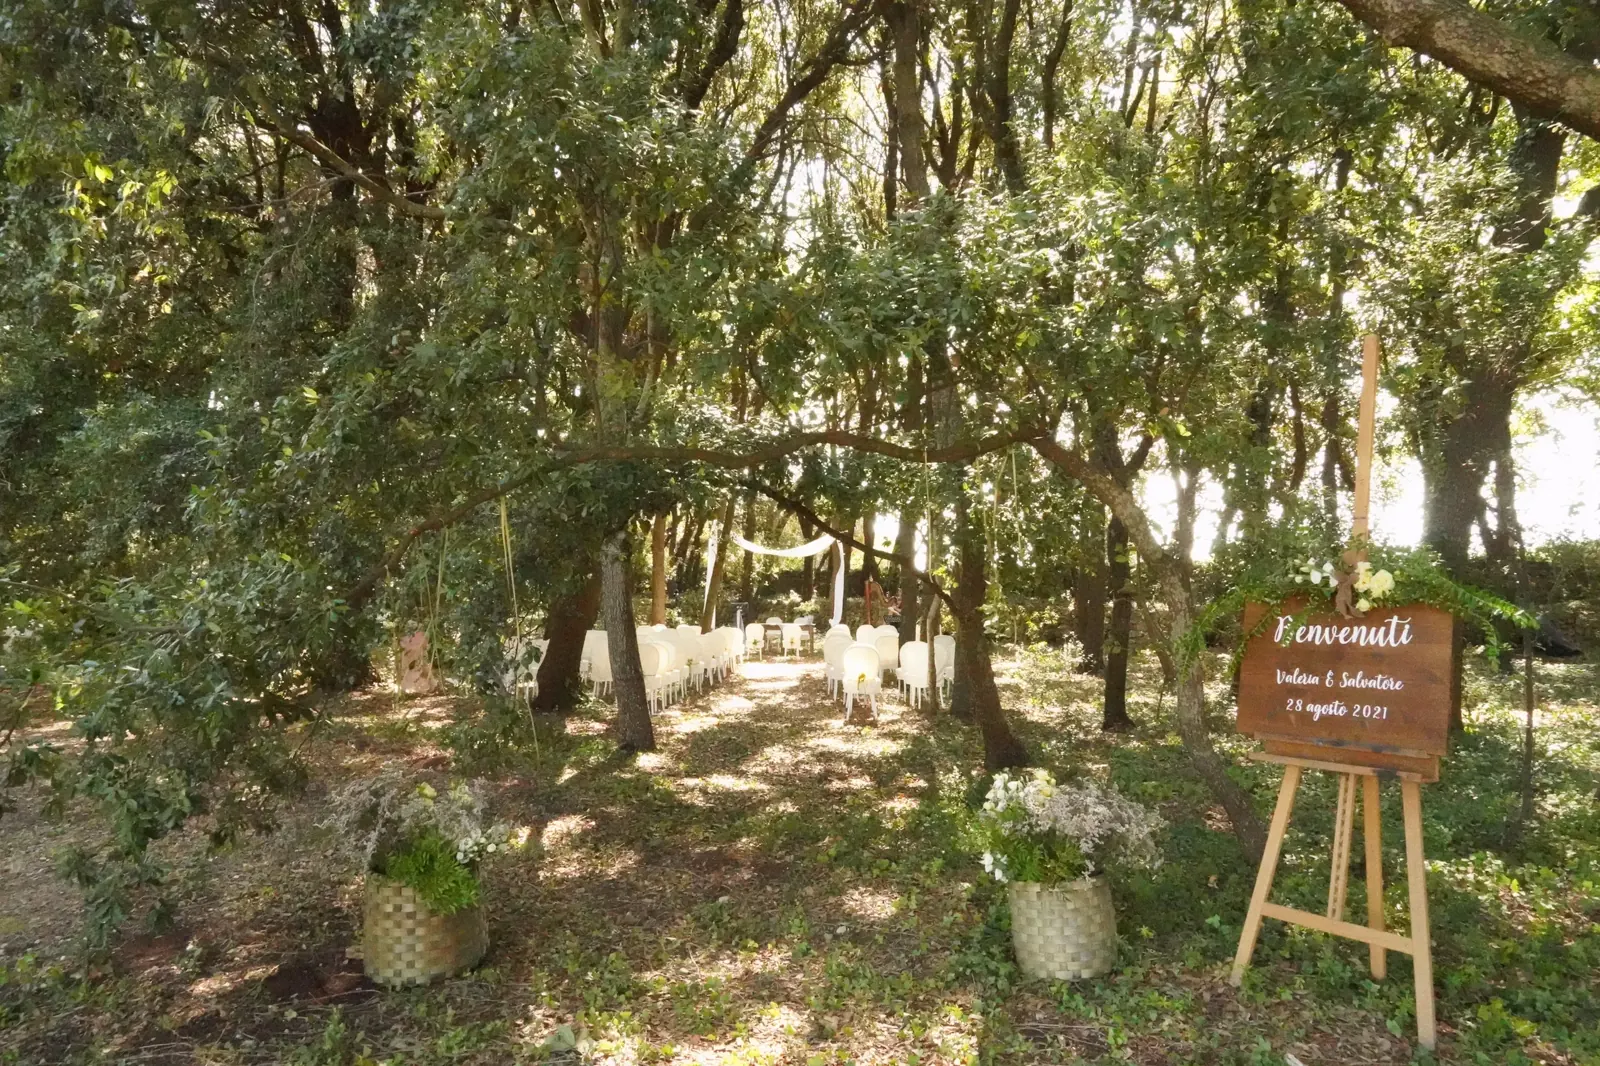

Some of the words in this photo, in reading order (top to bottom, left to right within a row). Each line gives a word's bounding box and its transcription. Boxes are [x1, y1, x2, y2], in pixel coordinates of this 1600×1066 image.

[1276, 667, 1319, 685] Valeria
[1325, 669, 1334, 688] &
[1339, 670, 1404, 691] Salvatore
[1286, 698, 1303, 712] 28
[1306, 700, 1348, 721] agosto
[1352, 704, 1388, 720] 2021
